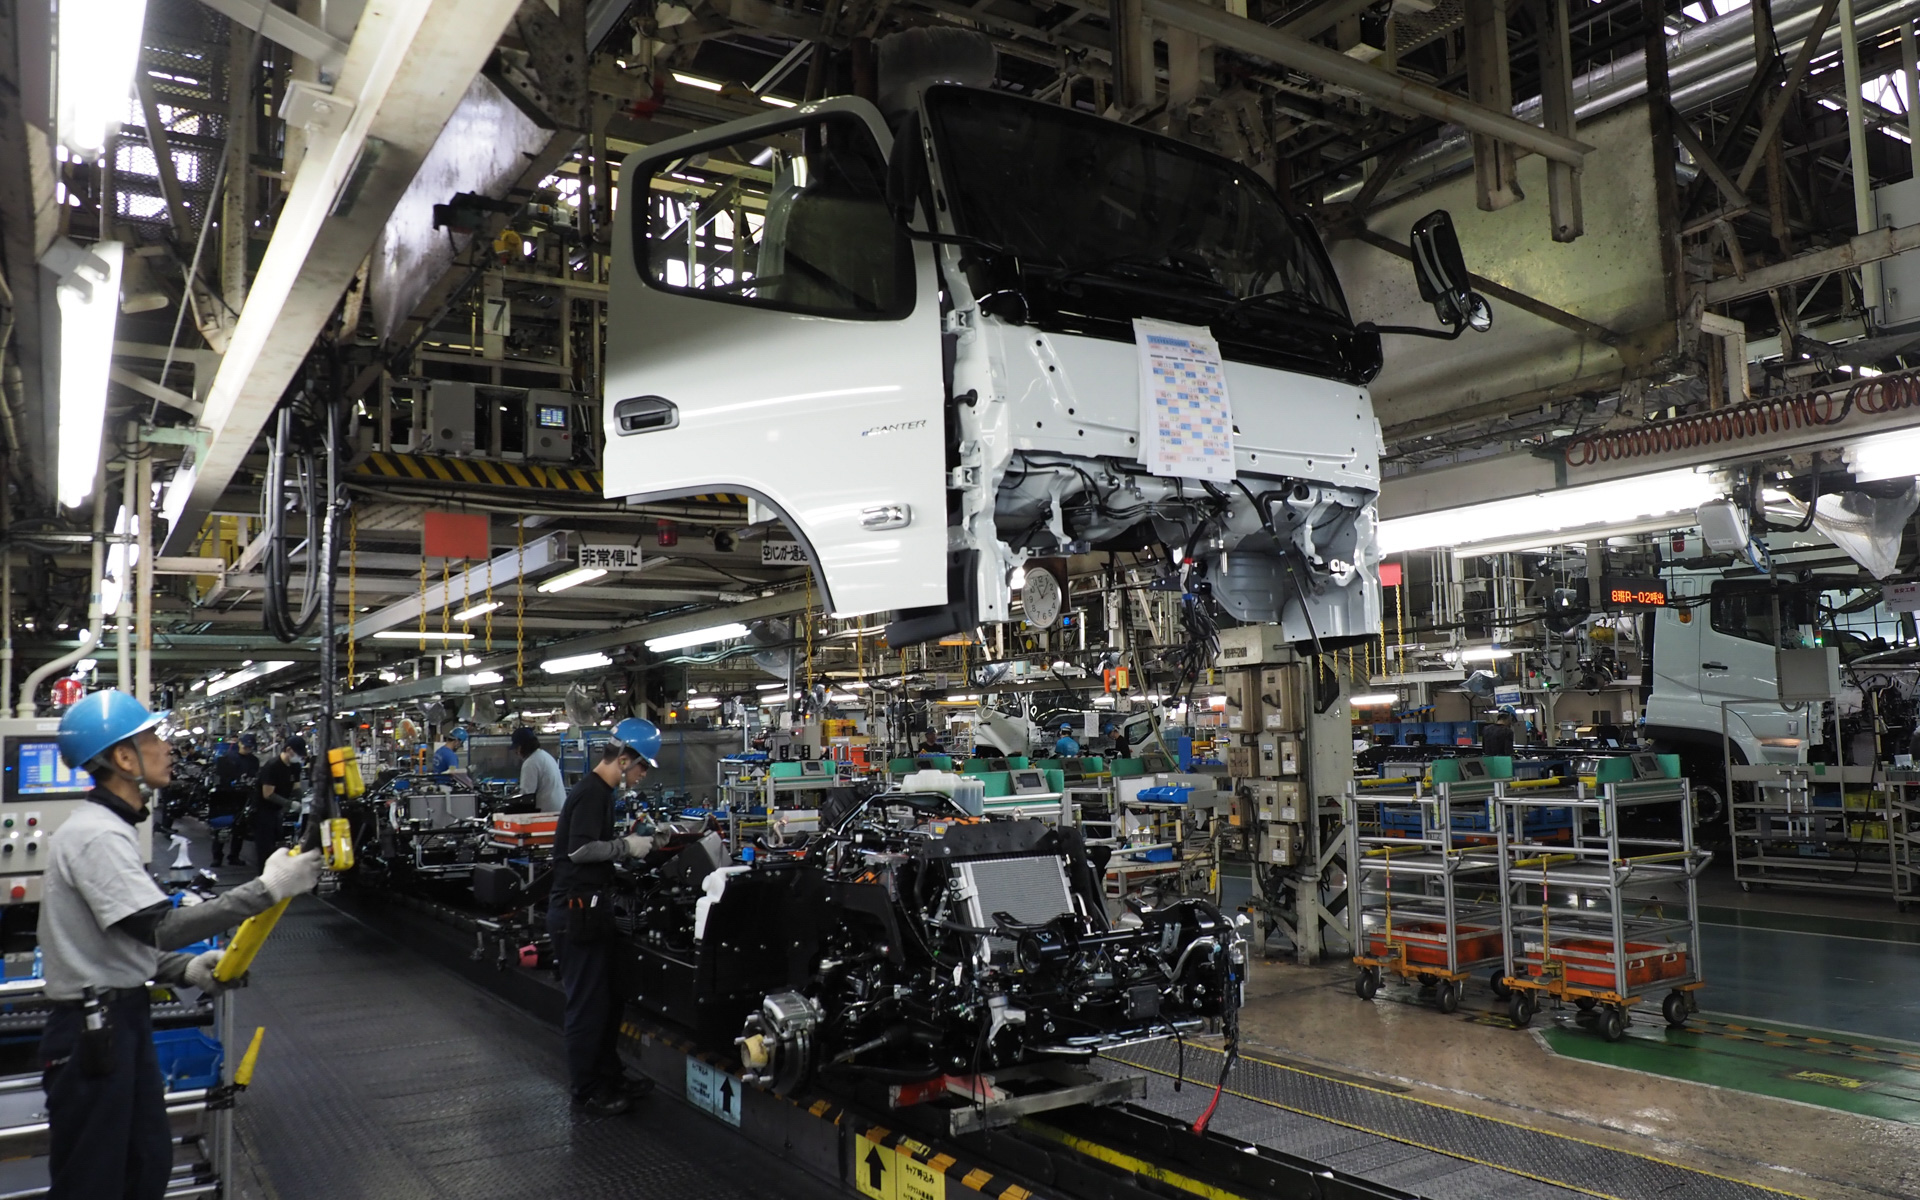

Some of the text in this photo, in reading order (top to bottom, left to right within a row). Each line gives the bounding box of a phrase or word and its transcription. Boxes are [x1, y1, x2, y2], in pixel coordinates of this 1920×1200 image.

[487, 299, 507, 331] 7
[581, 548, 638, 567] 非常停止
[1611, 590, 1665, 605] 8班R-02呼出
